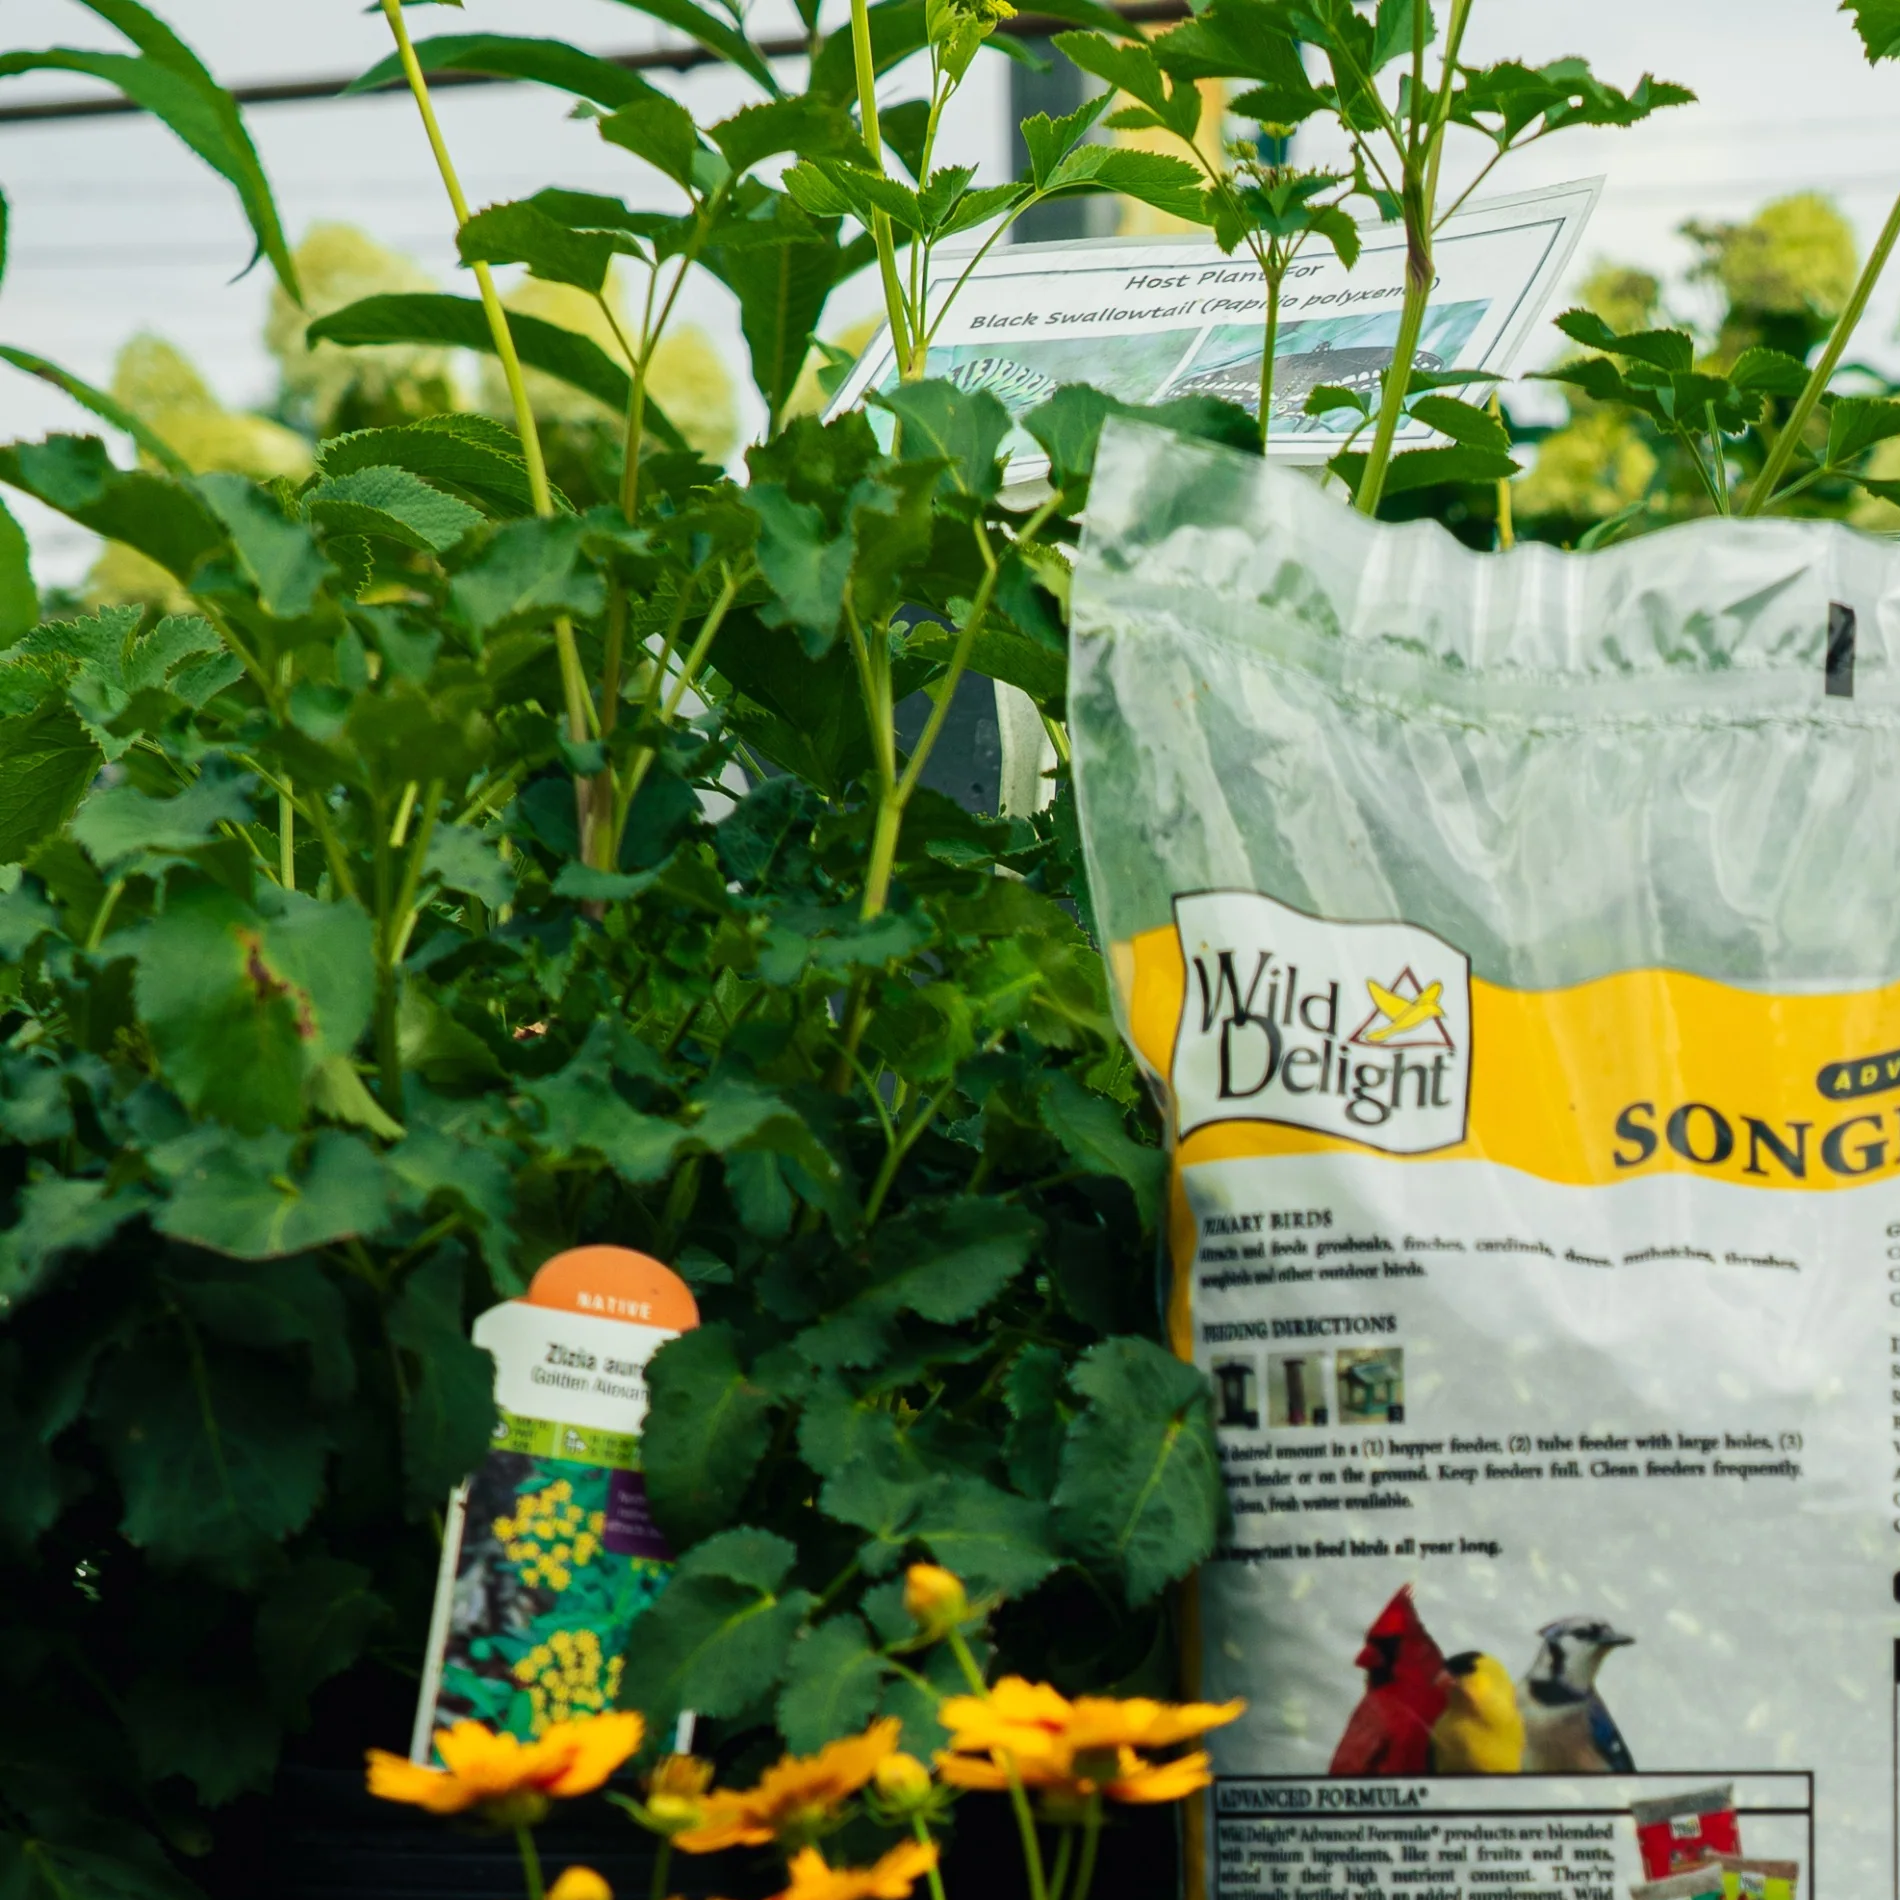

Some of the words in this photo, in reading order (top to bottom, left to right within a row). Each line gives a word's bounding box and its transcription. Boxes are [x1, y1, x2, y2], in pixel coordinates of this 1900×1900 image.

[1126, 274, 1189, 290] Host
[969, 311, 1037, 330] Black
[1045, 300, 1197, 325] Swallowtail
[1301, 277, 1440, 309] polyxen)
[1193, 951, 1340, 1036] Wild
[1217, 1013, 1453, 1126] Delight
[1270, 1210, 1333, 1230] BIRDS
[1318, 1263, 1379, 1280] outdoor
[576, 1291, 652, 1320] NATIVE
[1271, 1315, 1397, 1340] DIRECTIONS
[545, 1342, 598, 1370] Zizia
[603, 1356, 646, 1378] aur
[531, 1365, 589, 1391] Golden
[1362, 1437, 1384, 1458] (1)
[1387, 1438, 1443, 1459] hopper
[1509, 1434, 1531, 1455] (2)
[1536, 1434, 1573, 1451] tube
[1578, 1433, 1629, 1450] feeder
[1635, 1433, 1672, 1450] with
[1677, 1432, 1719, 1454] large
[1778, 1430, 1803, 1453] (3)
[1342, 1466, 1365, 1484] the
[1371, 1466, 1431, 1487] ground.
[1437, 1465, 1479, 1485] Keep
[1485, 1462, 1544, 1480] feeders
[1590, 1460, 1639, 1478] Clean
[1646, 1460, 1706, 1477] feeders
[1713, 1459, 1803, 1482] frequently.
[1350, 1539, 1389, 1556] birds
[1394, 1538, 1415, 1555] all
[1419, 1541, 1455, 1560] year
[1459, 1537, 1502, 1558] long.
[1220, 1790, 1311, 1808] ADVANCED
[1548, 1824, 1614, 1840] blended
[1477, 1846, 1522, 1862] fruits
[1532, 1846, 1563, 1862] and
